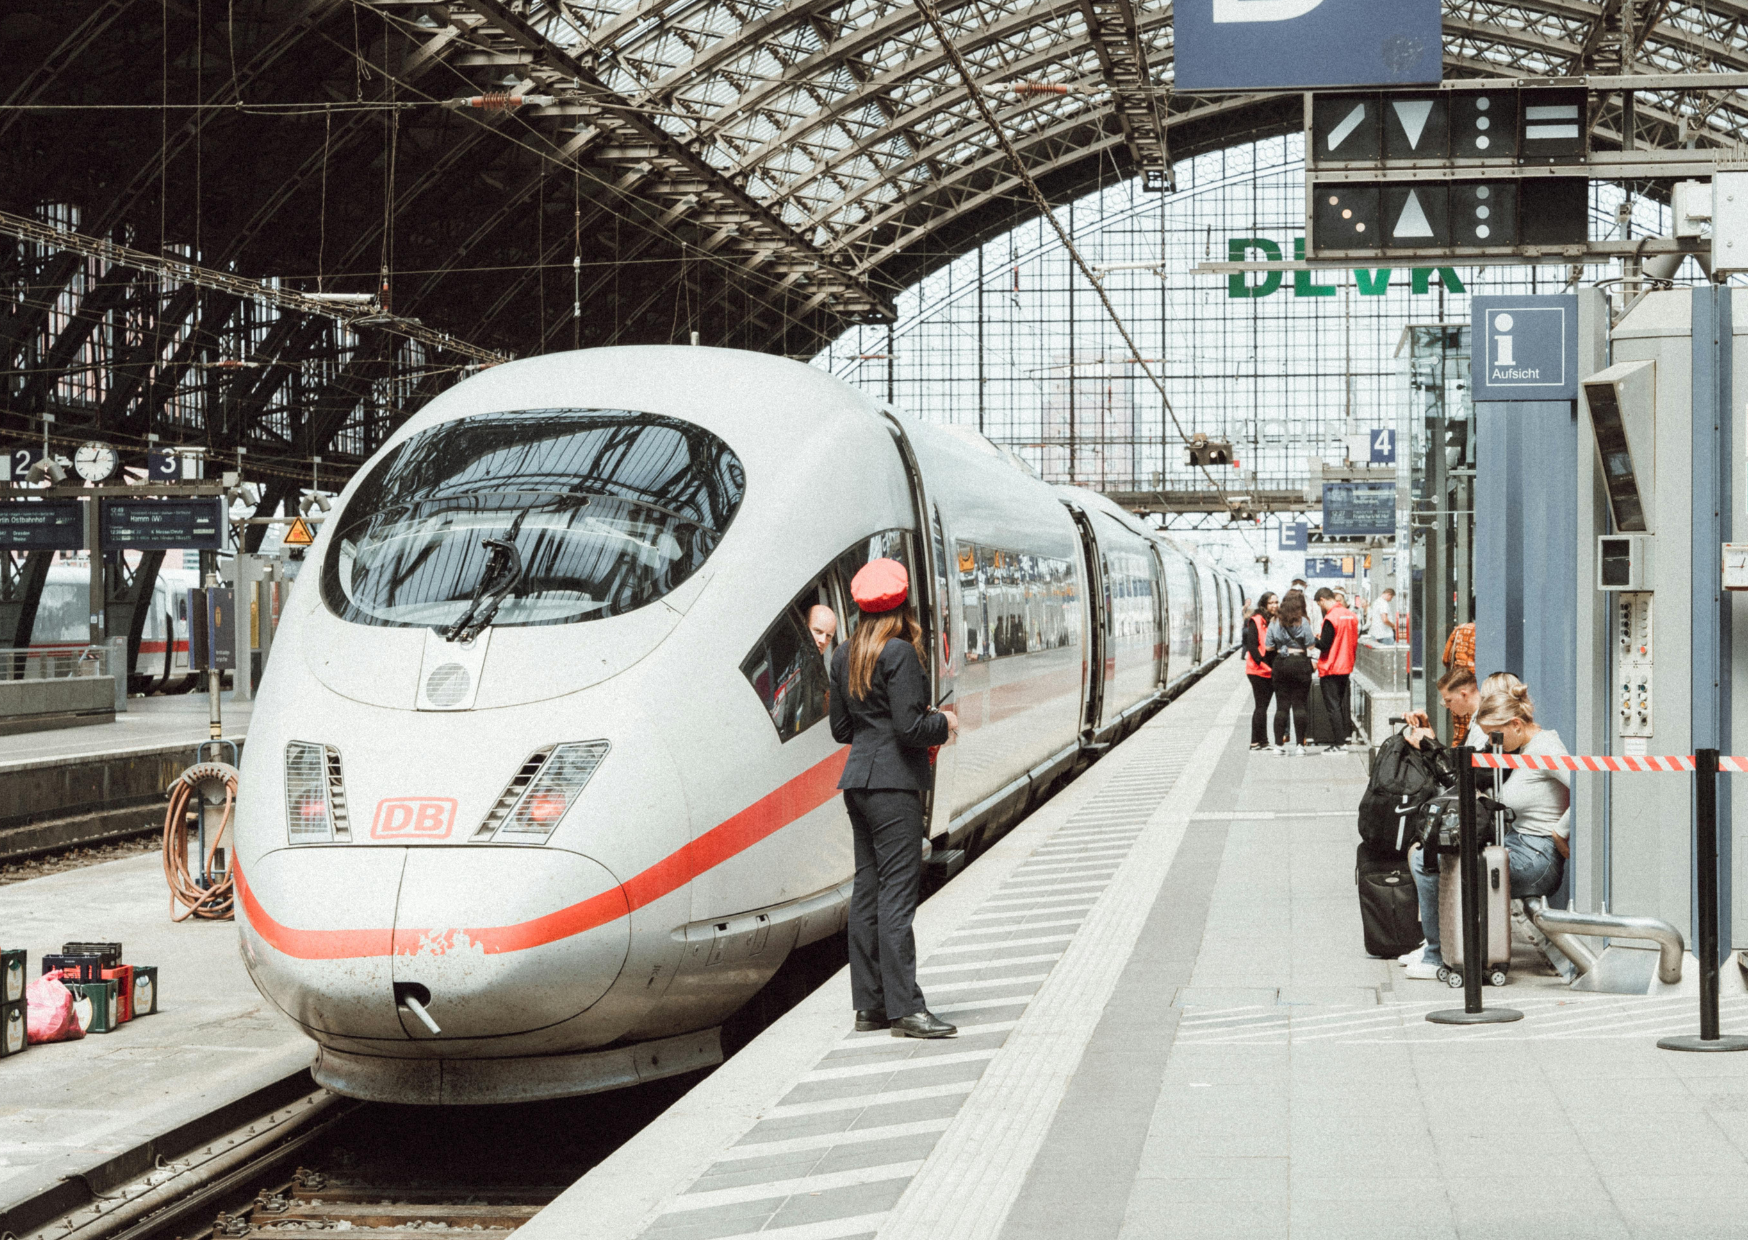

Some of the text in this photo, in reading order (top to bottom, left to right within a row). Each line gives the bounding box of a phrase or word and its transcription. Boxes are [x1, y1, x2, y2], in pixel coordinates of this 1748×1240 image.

[1492, 368, 1540, 379] Aufsicht
[1373, 429, 1392, 456] 4
[15, 450, 31, 475] 2
[160, 447, 177, 474] 3
[11, 516, 46, 524] Ostbahnhof
[1281, 522, 1297, 546] E
[1316, 559, 1325, 574] F
[380, 802, 447, 833] DB
